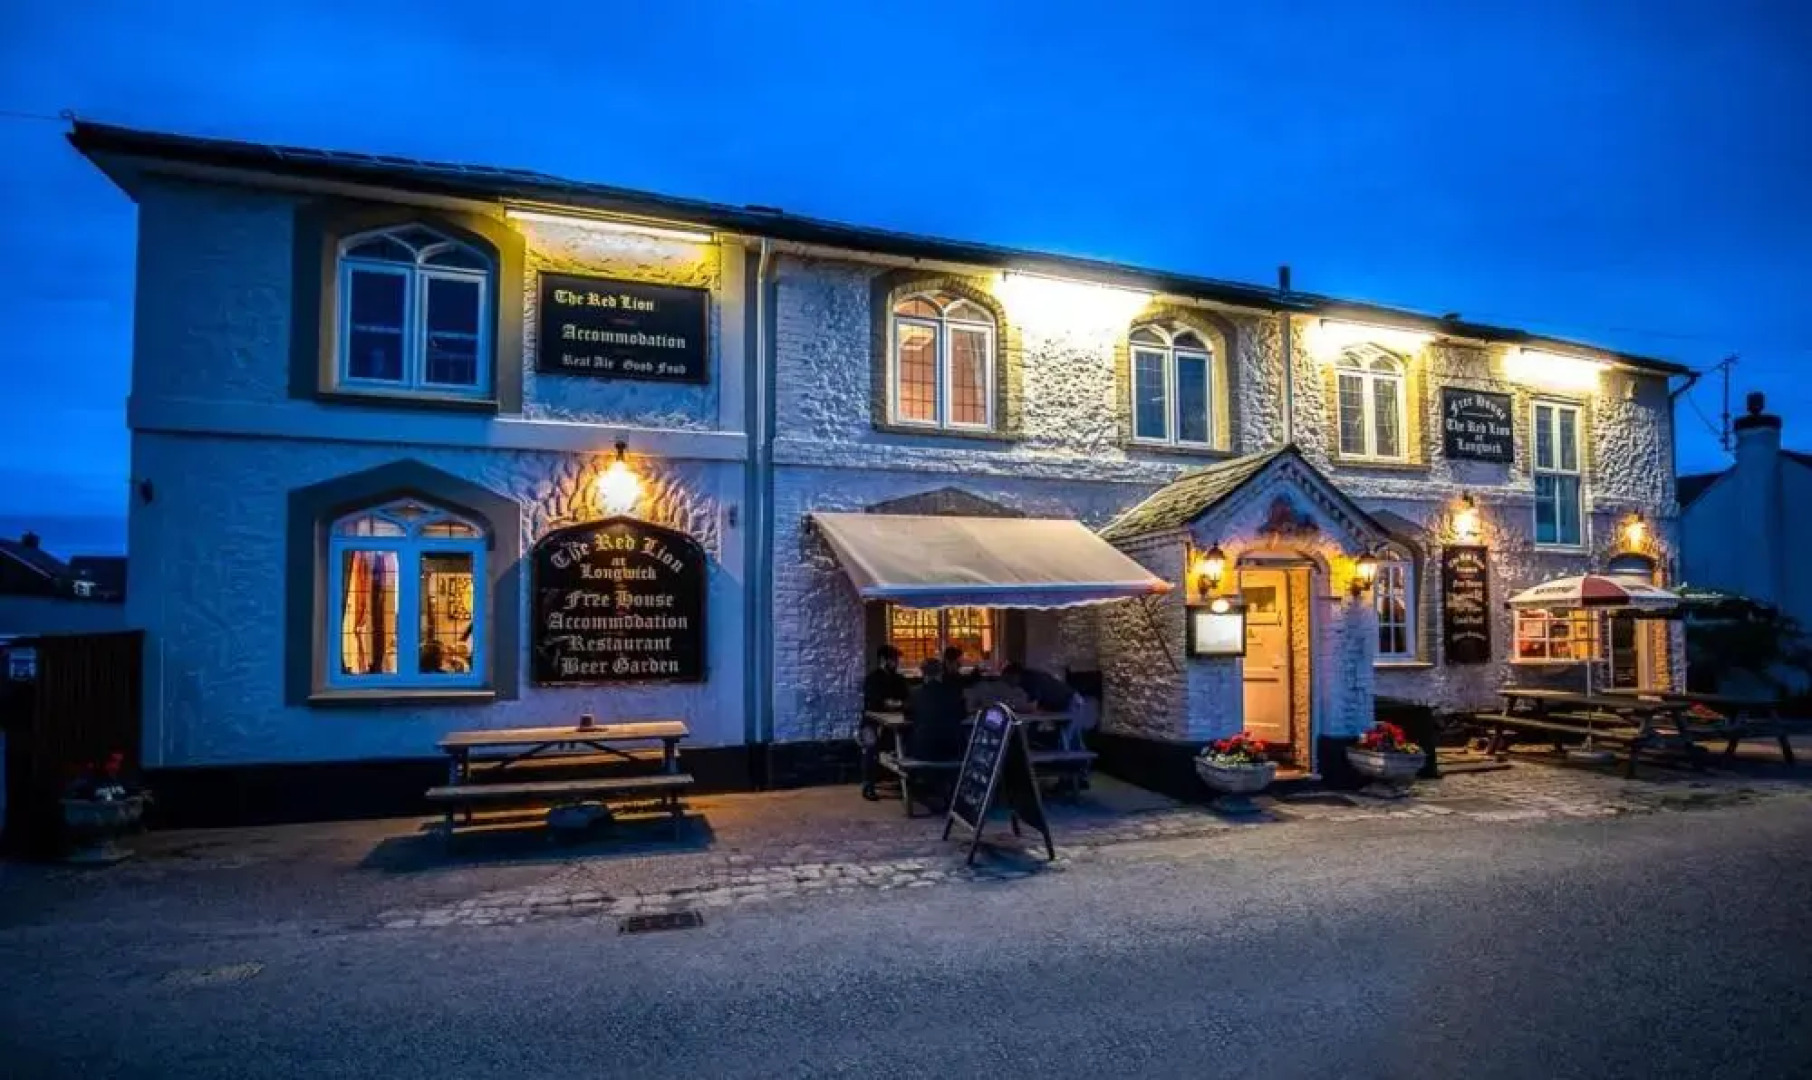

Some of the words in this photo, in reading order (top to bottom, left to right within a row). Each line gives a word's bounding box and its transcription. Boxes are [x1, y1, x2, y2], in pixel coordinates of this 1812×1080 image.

[554, 289, 584, 305] The
[587, 291, 617, 307] Red
[620, 294, 655, 312] Lion
[561, 323, 686, 349] Accommodation
[562, 353, 590, 367] Real
[622, 358, 653, 371] Good
[550, 540, 590, 568] The
[593, 533, 635, 551] Red
[639, 537, 684, 573] Lion
[611, 557, 626, 566] at
[579, 563, 657, 582] Longwick
[562, 590, 610, 609] Free
[615, 590, 675, 609] House
[548, 612, 688, 630] Accommodation
[569, 635, 672, 651] Restaurant
[560, 657, 610, 676] Beer
[612, 657, 680, 675] Garden
